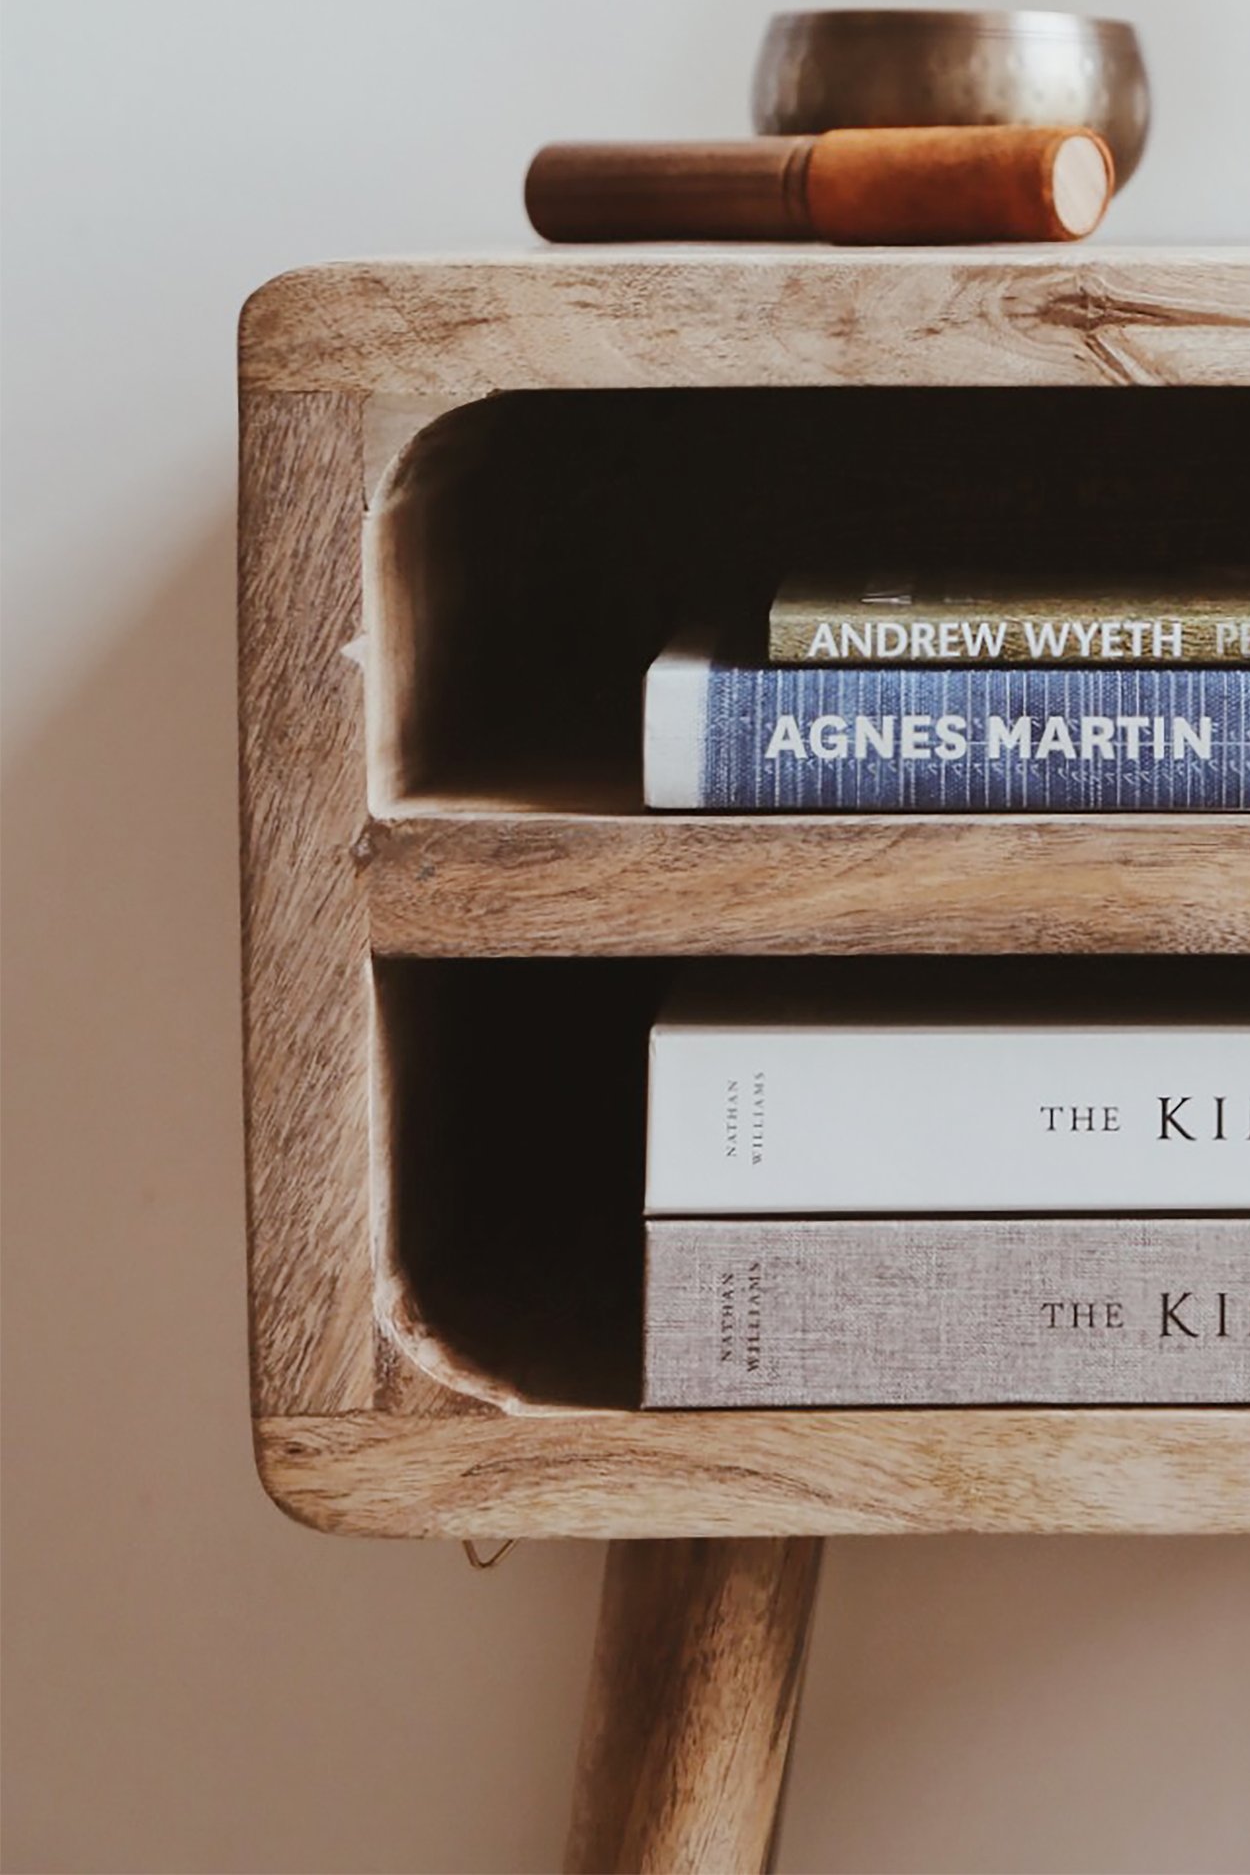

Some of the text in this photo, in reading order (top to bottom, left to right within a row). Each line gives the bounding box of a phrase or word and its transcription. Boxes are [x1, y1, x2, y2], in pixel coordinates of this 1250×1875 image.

[808, 622, 1006, 658] ANDREW
[1025, 622, 1183, 658] WYETH
[764, 715, 1212, 760] AGNES MARTIN
[725, 1079, 738, 1158] NATHAN
[751, 1071, 765, 1167] WILLIAMS
[1039, 1105, 1121, 1132] THE
[719, 1272, 735, 1363] NATHAN
[745, 1261, 763, 1373] WILLIAMS
[1040, 1302, 1124, 1329] THE
